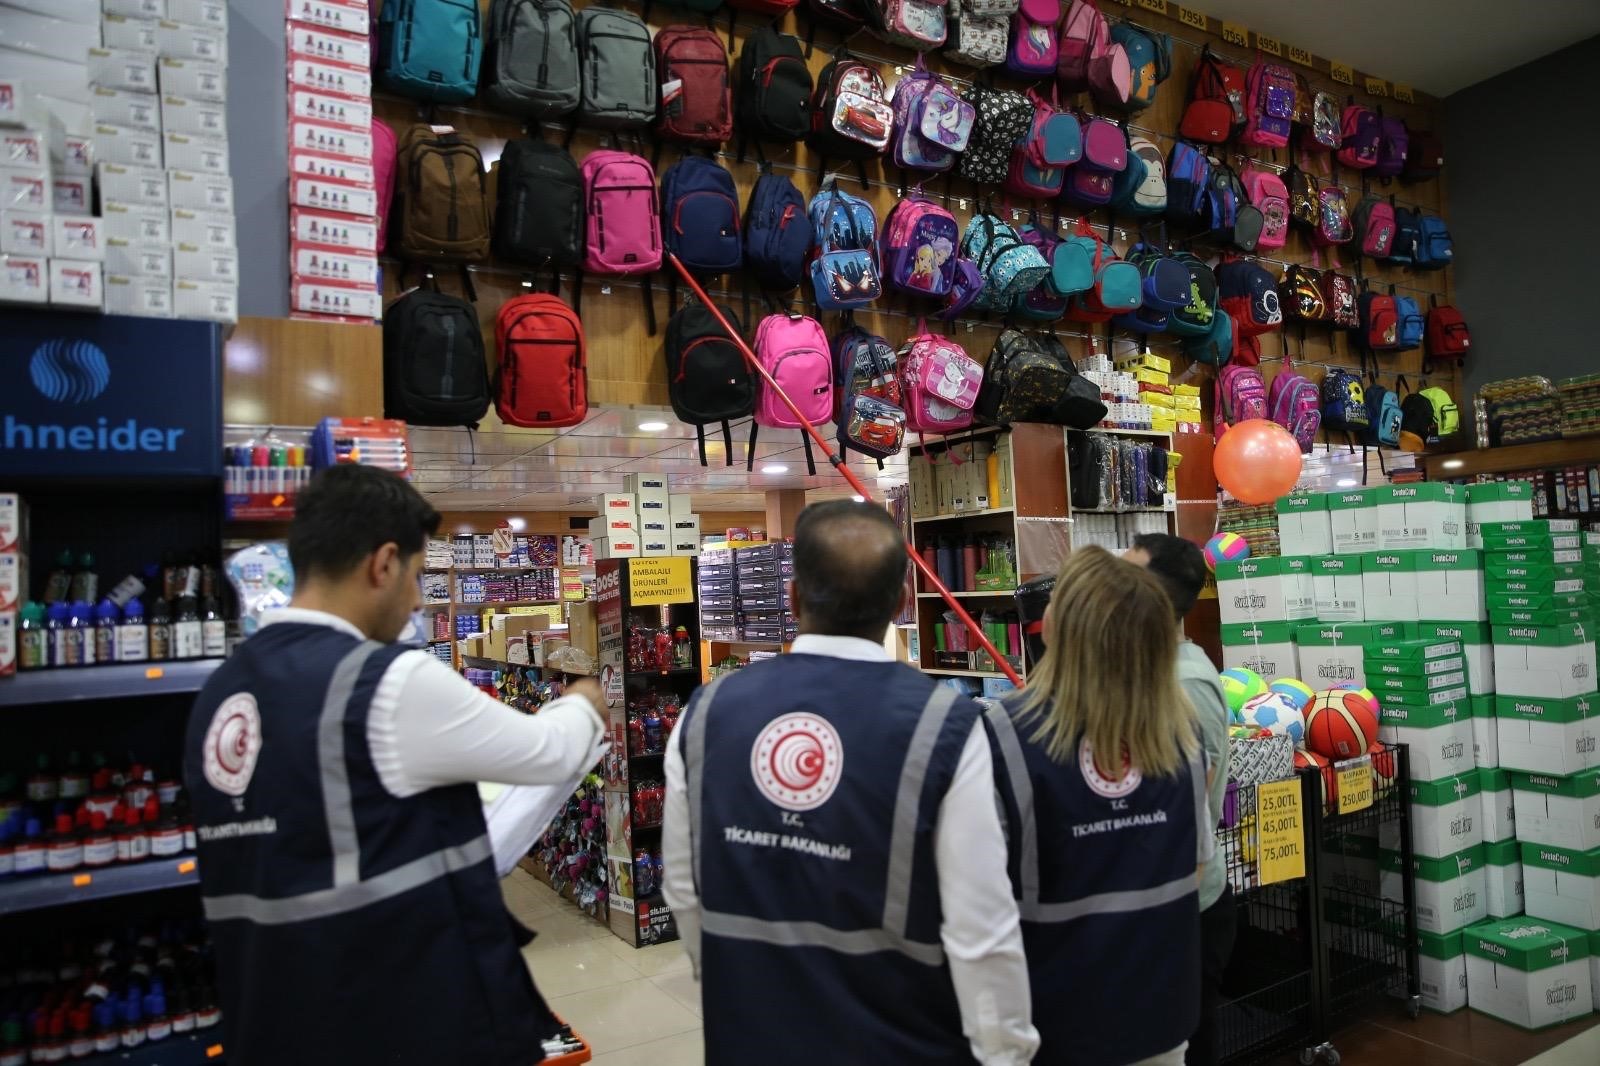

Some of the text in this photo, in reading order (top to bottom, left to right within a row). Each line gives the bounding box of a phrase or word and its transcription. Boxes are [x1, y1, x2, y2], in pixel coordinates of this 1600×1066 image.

[632, 568, 671, 576] AMBALAJLI
[633, 577, 668, 587] ÜRÜNLERİ
[1508, 627, 1538, 638] SvetoCopy
[1263, 794, 1297, 811] 25,00TL
[1072, 819, 1113, 838] TİCARET
[1263, 816, 1299, 835] 45,00TL
[723, 825, 852, 862] TİCARET BAKANLIĞI
[1263, 842, 1300, 861] 75,00TL
